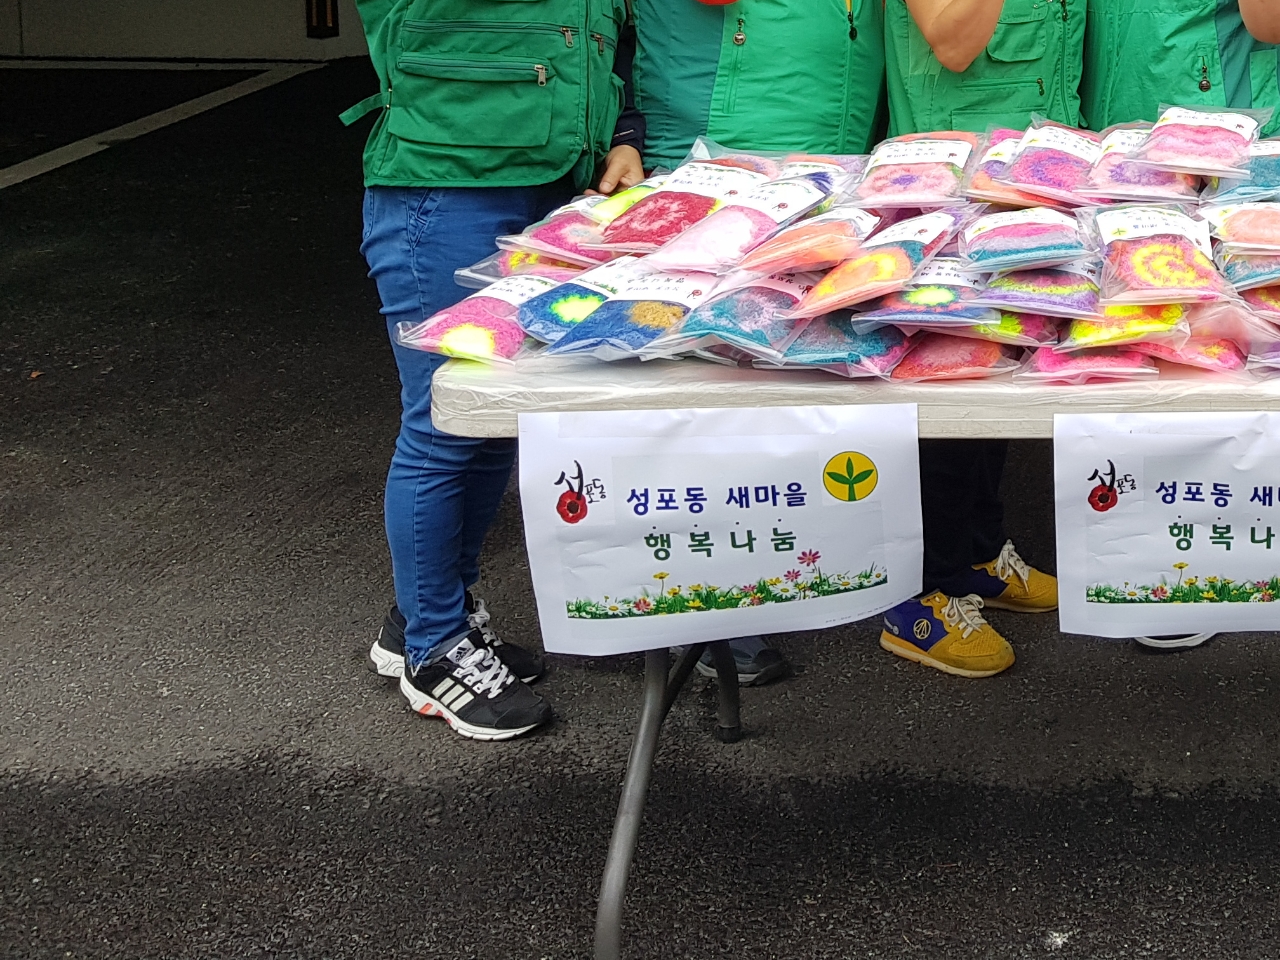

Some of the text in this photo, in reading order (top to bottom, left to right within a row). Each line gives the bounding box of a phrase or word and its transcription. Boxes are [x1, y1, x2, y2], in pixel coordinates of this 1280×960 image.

[626, 482, 808, 516] 성포동 새마을
[1155, 481, 1233, 508] 성포동
